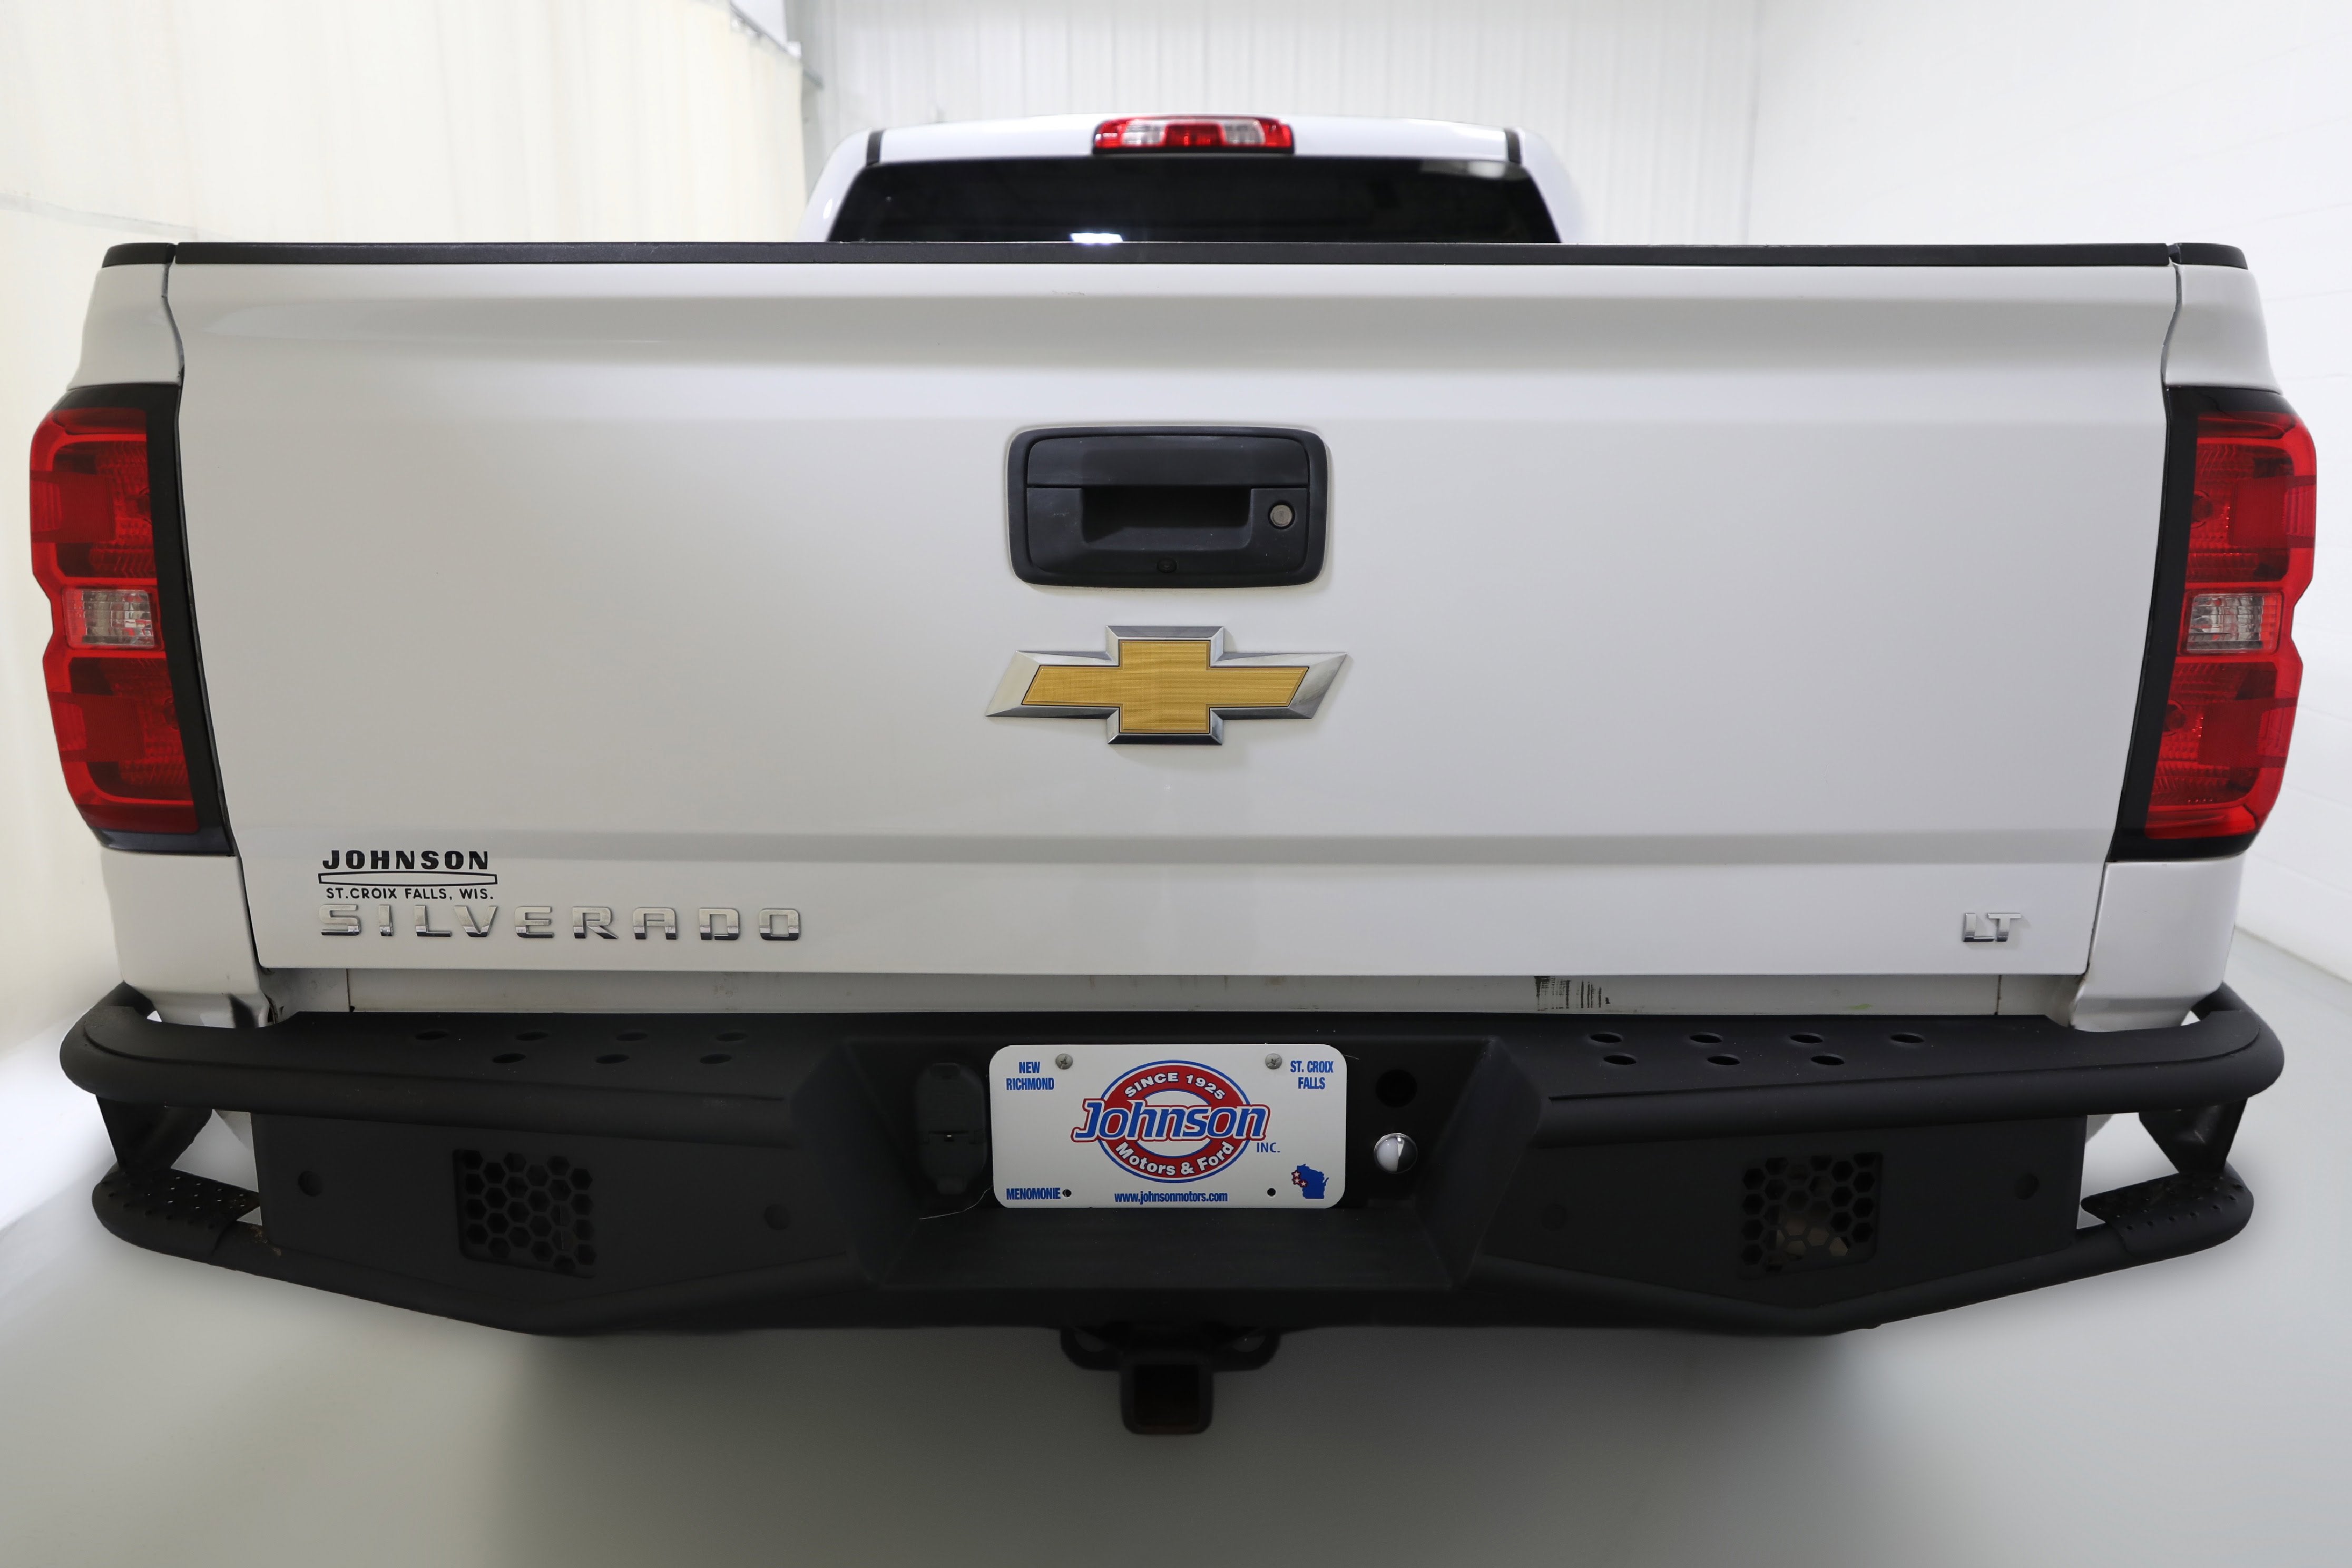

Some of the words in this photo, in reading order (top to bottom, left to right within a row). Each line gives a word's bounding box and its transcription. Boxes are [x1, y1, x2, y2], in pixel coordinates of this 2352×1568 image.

[322, 850, 488, 870] JOHNSON
[405, 887, 452, 900] FALLS,
[459, 887, 494, 900] WIS.
[318, 904, 802, 941] SILVERADO
[1962, 913, 2022, 942] LT
[1018, 1061, 1041, 1074] NEW
[1290, 1060, 1305, 1073] ST.
[1307, 1060, 1334, 1073] CROIX
[1006, 1077, 1054, 1090] RICHMOND
[1124, 1072, 1179, 1099] SINCE
[1185, 1074, 1226, 1101] 1925
[1298, 1076, 1326, 1090] FALLS
[1073, 1100, 1269, 1139] Johnson
[1256, 1142, 1281, 1153] INC.
[1114, 1142, 1176, 1177] Motors
[1180, 1162, 1195, 1175] &
[1197, 1141, 1234, 1171] Ford
[1006, 1187, 1061, 1200] MENOMONIE
[1114, 1191, 1228, 1204] www.johnsonmotors.com
